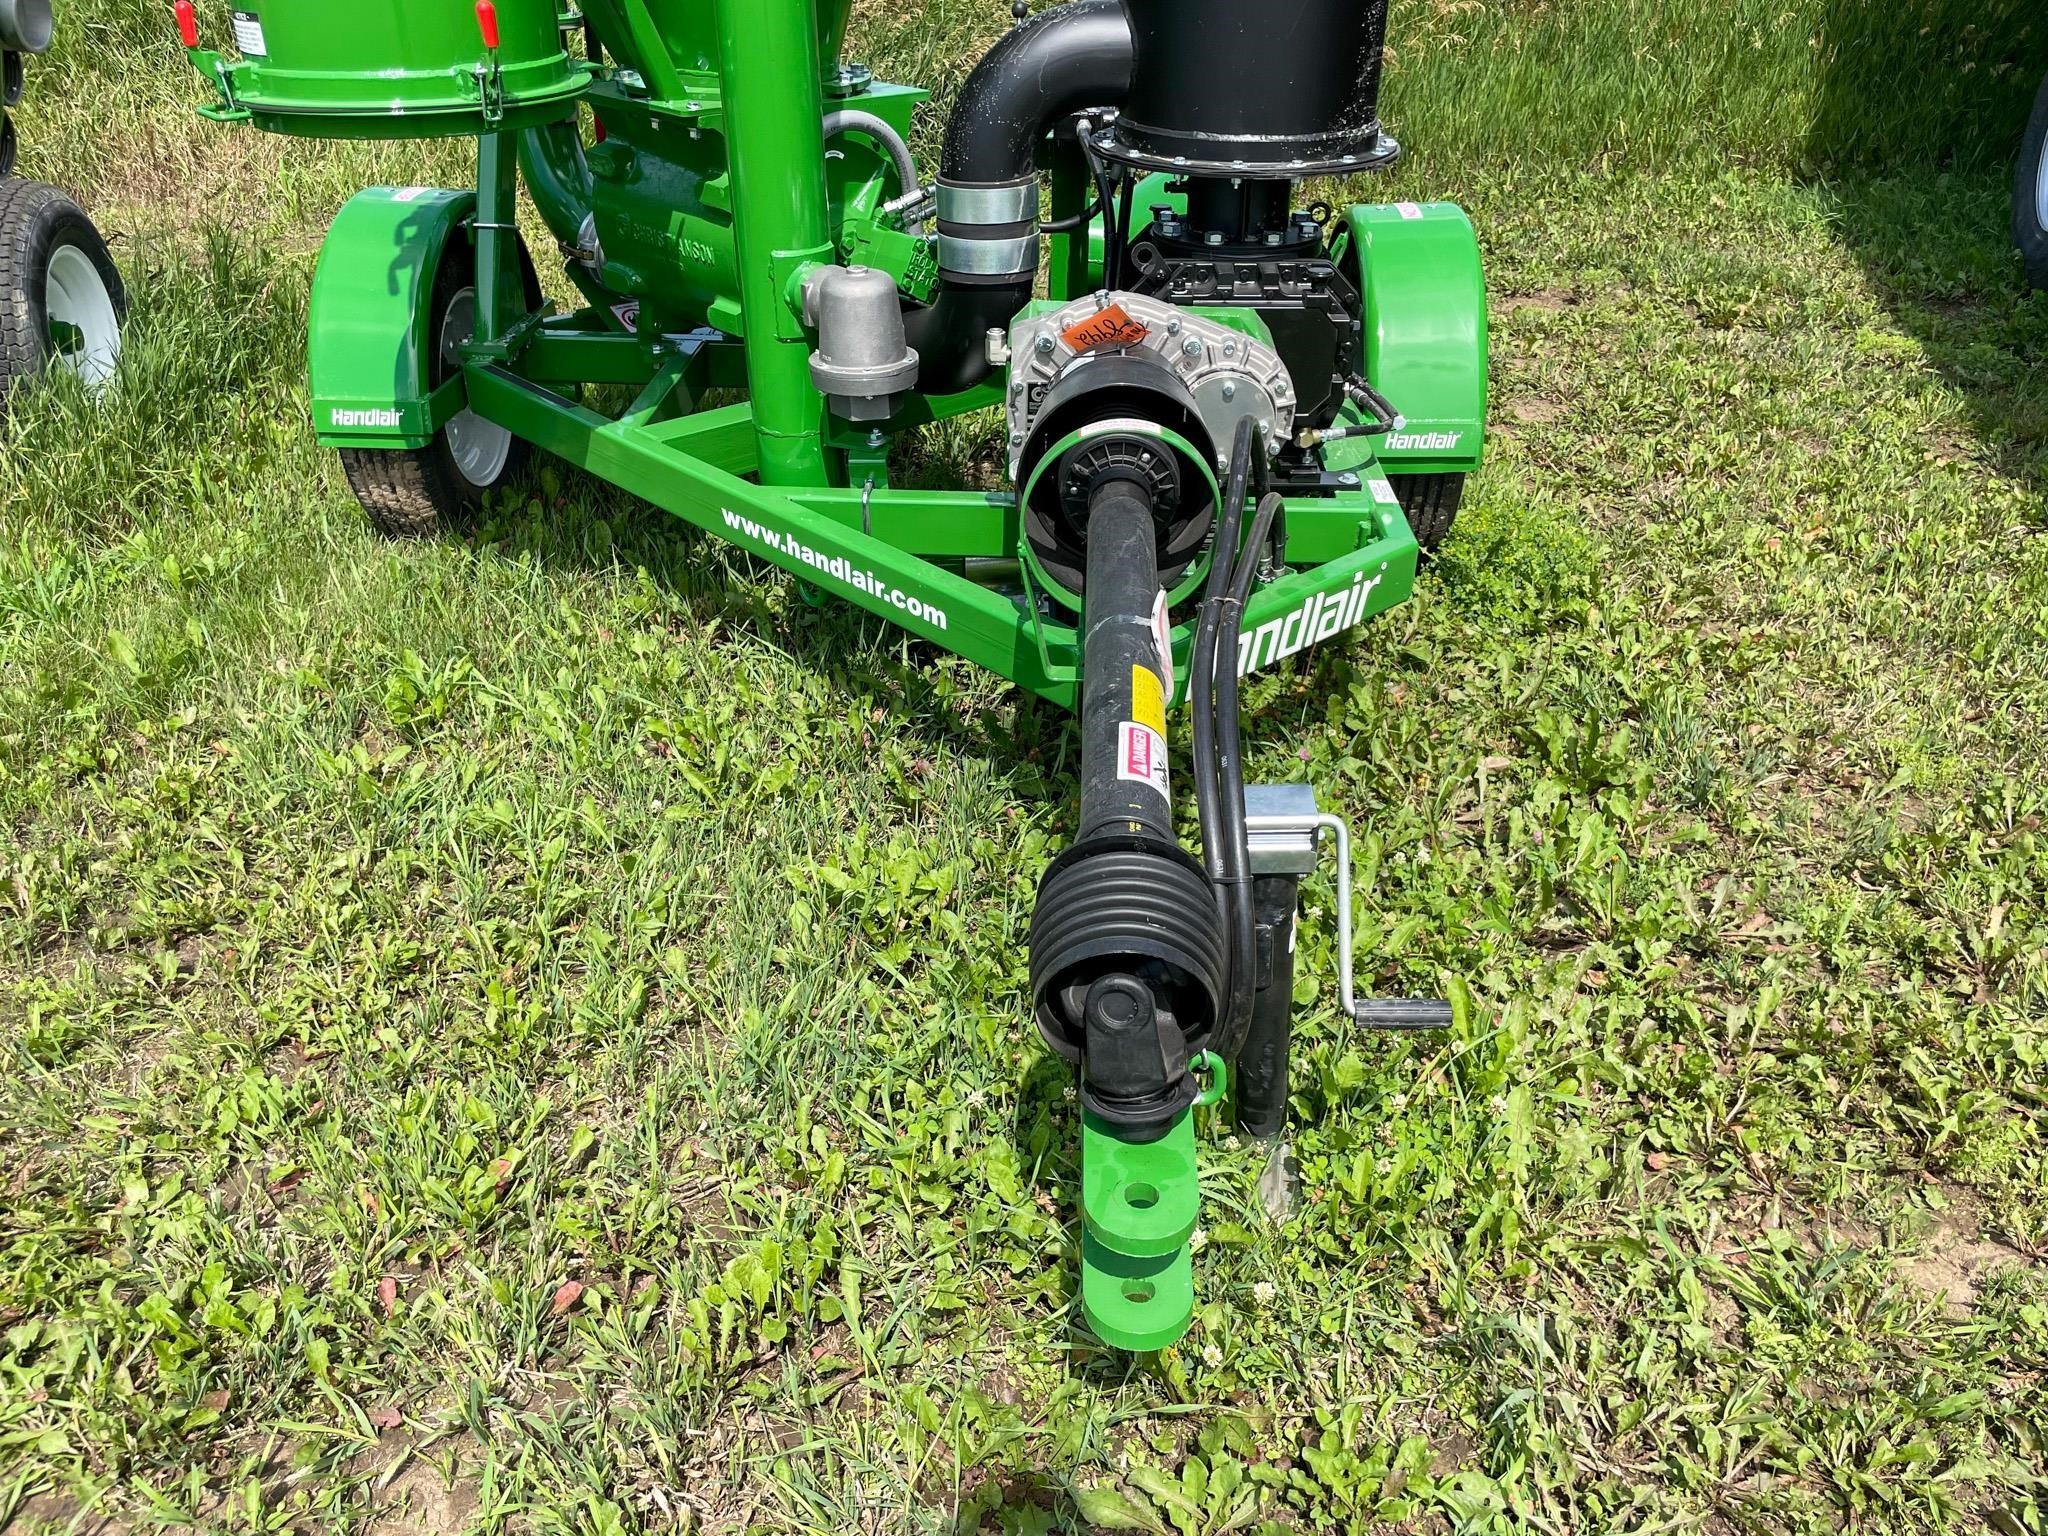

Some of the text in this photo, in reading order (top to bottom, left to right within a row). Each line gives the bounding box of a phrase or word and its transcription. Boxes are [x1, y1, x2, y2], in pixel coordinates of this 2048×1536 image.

[332, 408, 402, 426] Handlair
[1385, 431, 1461, 449] Handlair
[721, 508, 947, 630] www.handlair.com
[1212, 570, 1381, 682] andlair
[1132, 728, 1147, 763] DANGER
